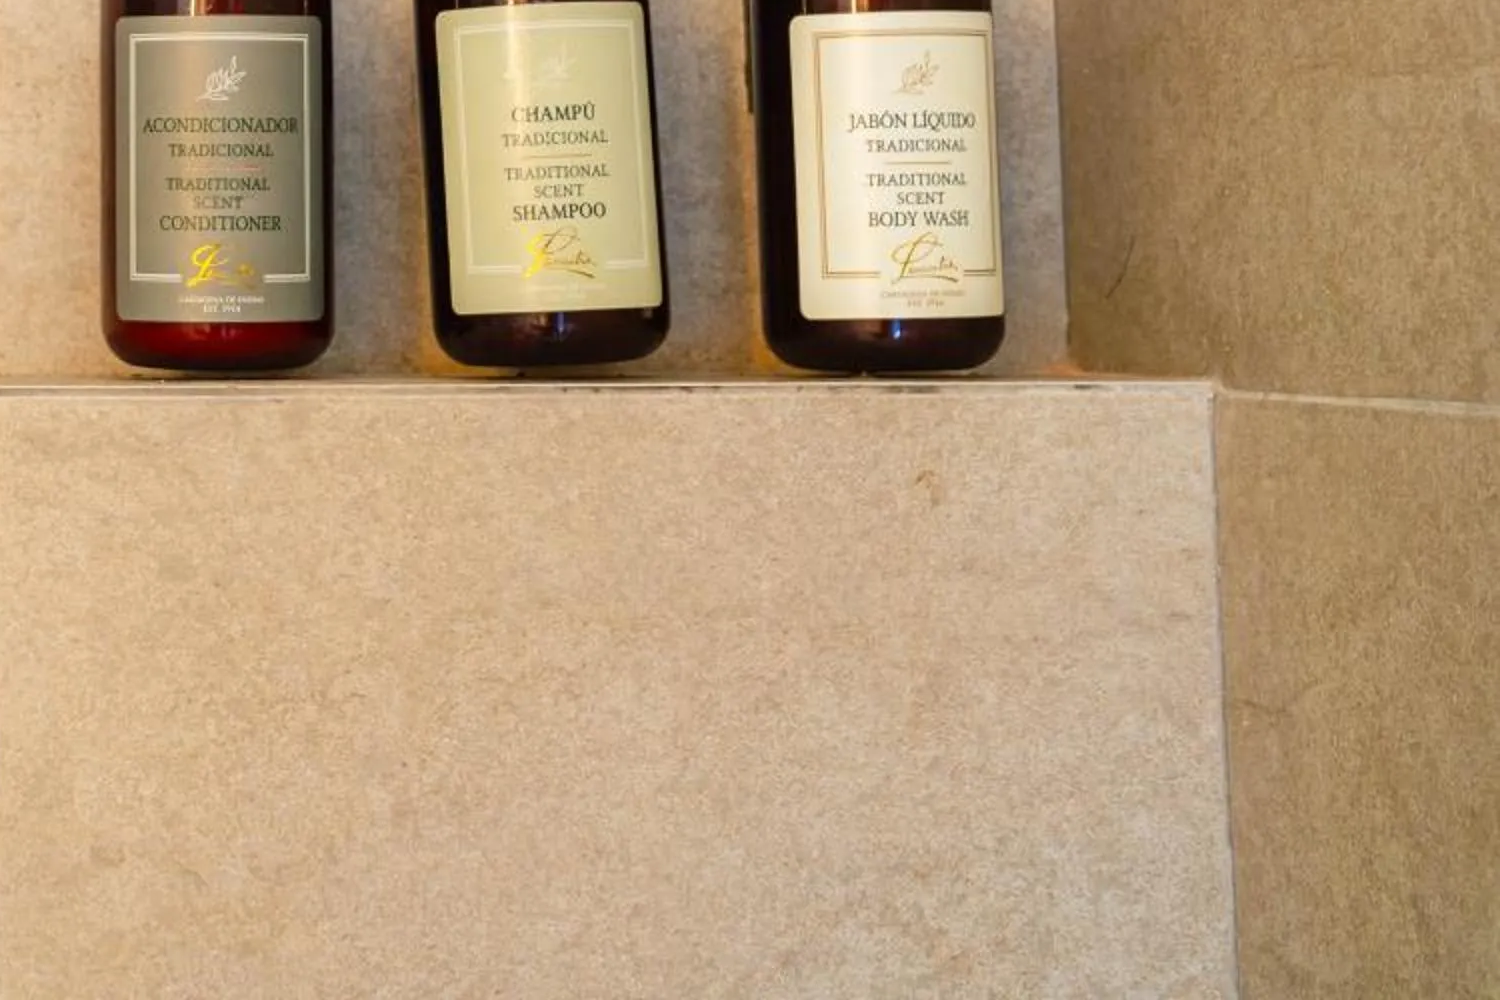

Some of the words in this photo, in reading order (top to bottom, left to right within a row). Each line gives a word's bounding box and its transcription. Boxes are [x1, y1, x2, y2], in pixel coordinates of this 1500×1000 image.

[511, 100, 596, 123] CHAMPÚ
[143, 117, 299, 133] ACONDICIONADOR
[847, 110, 907, 133] JABÓN
[912, 109, 976, 132] LÍQUIDO
[501, 129, 609, 147] TRADICIONAL
[866, 138, 967, 153] TRADICIONAL
[168, 143, 274, 157] TRADICIONAL
[504, 163, 611, 181] TRADITIONAL
[866, 173, 967, 187] TRADITIONAL
[165, 177, 271, 191] TRADITIONAL
[533, 184, 585, 199] SCENT
[193, 196, 244, 210] SCENT
[897, 191, 946, 205] SCENT
[512, 202, 607, 222] SHAMPOO
[868, 211, 918, 228] BODY
[923, 210, 970, 226] WASH
[159, 215, 282, 231] CONDITIONER
